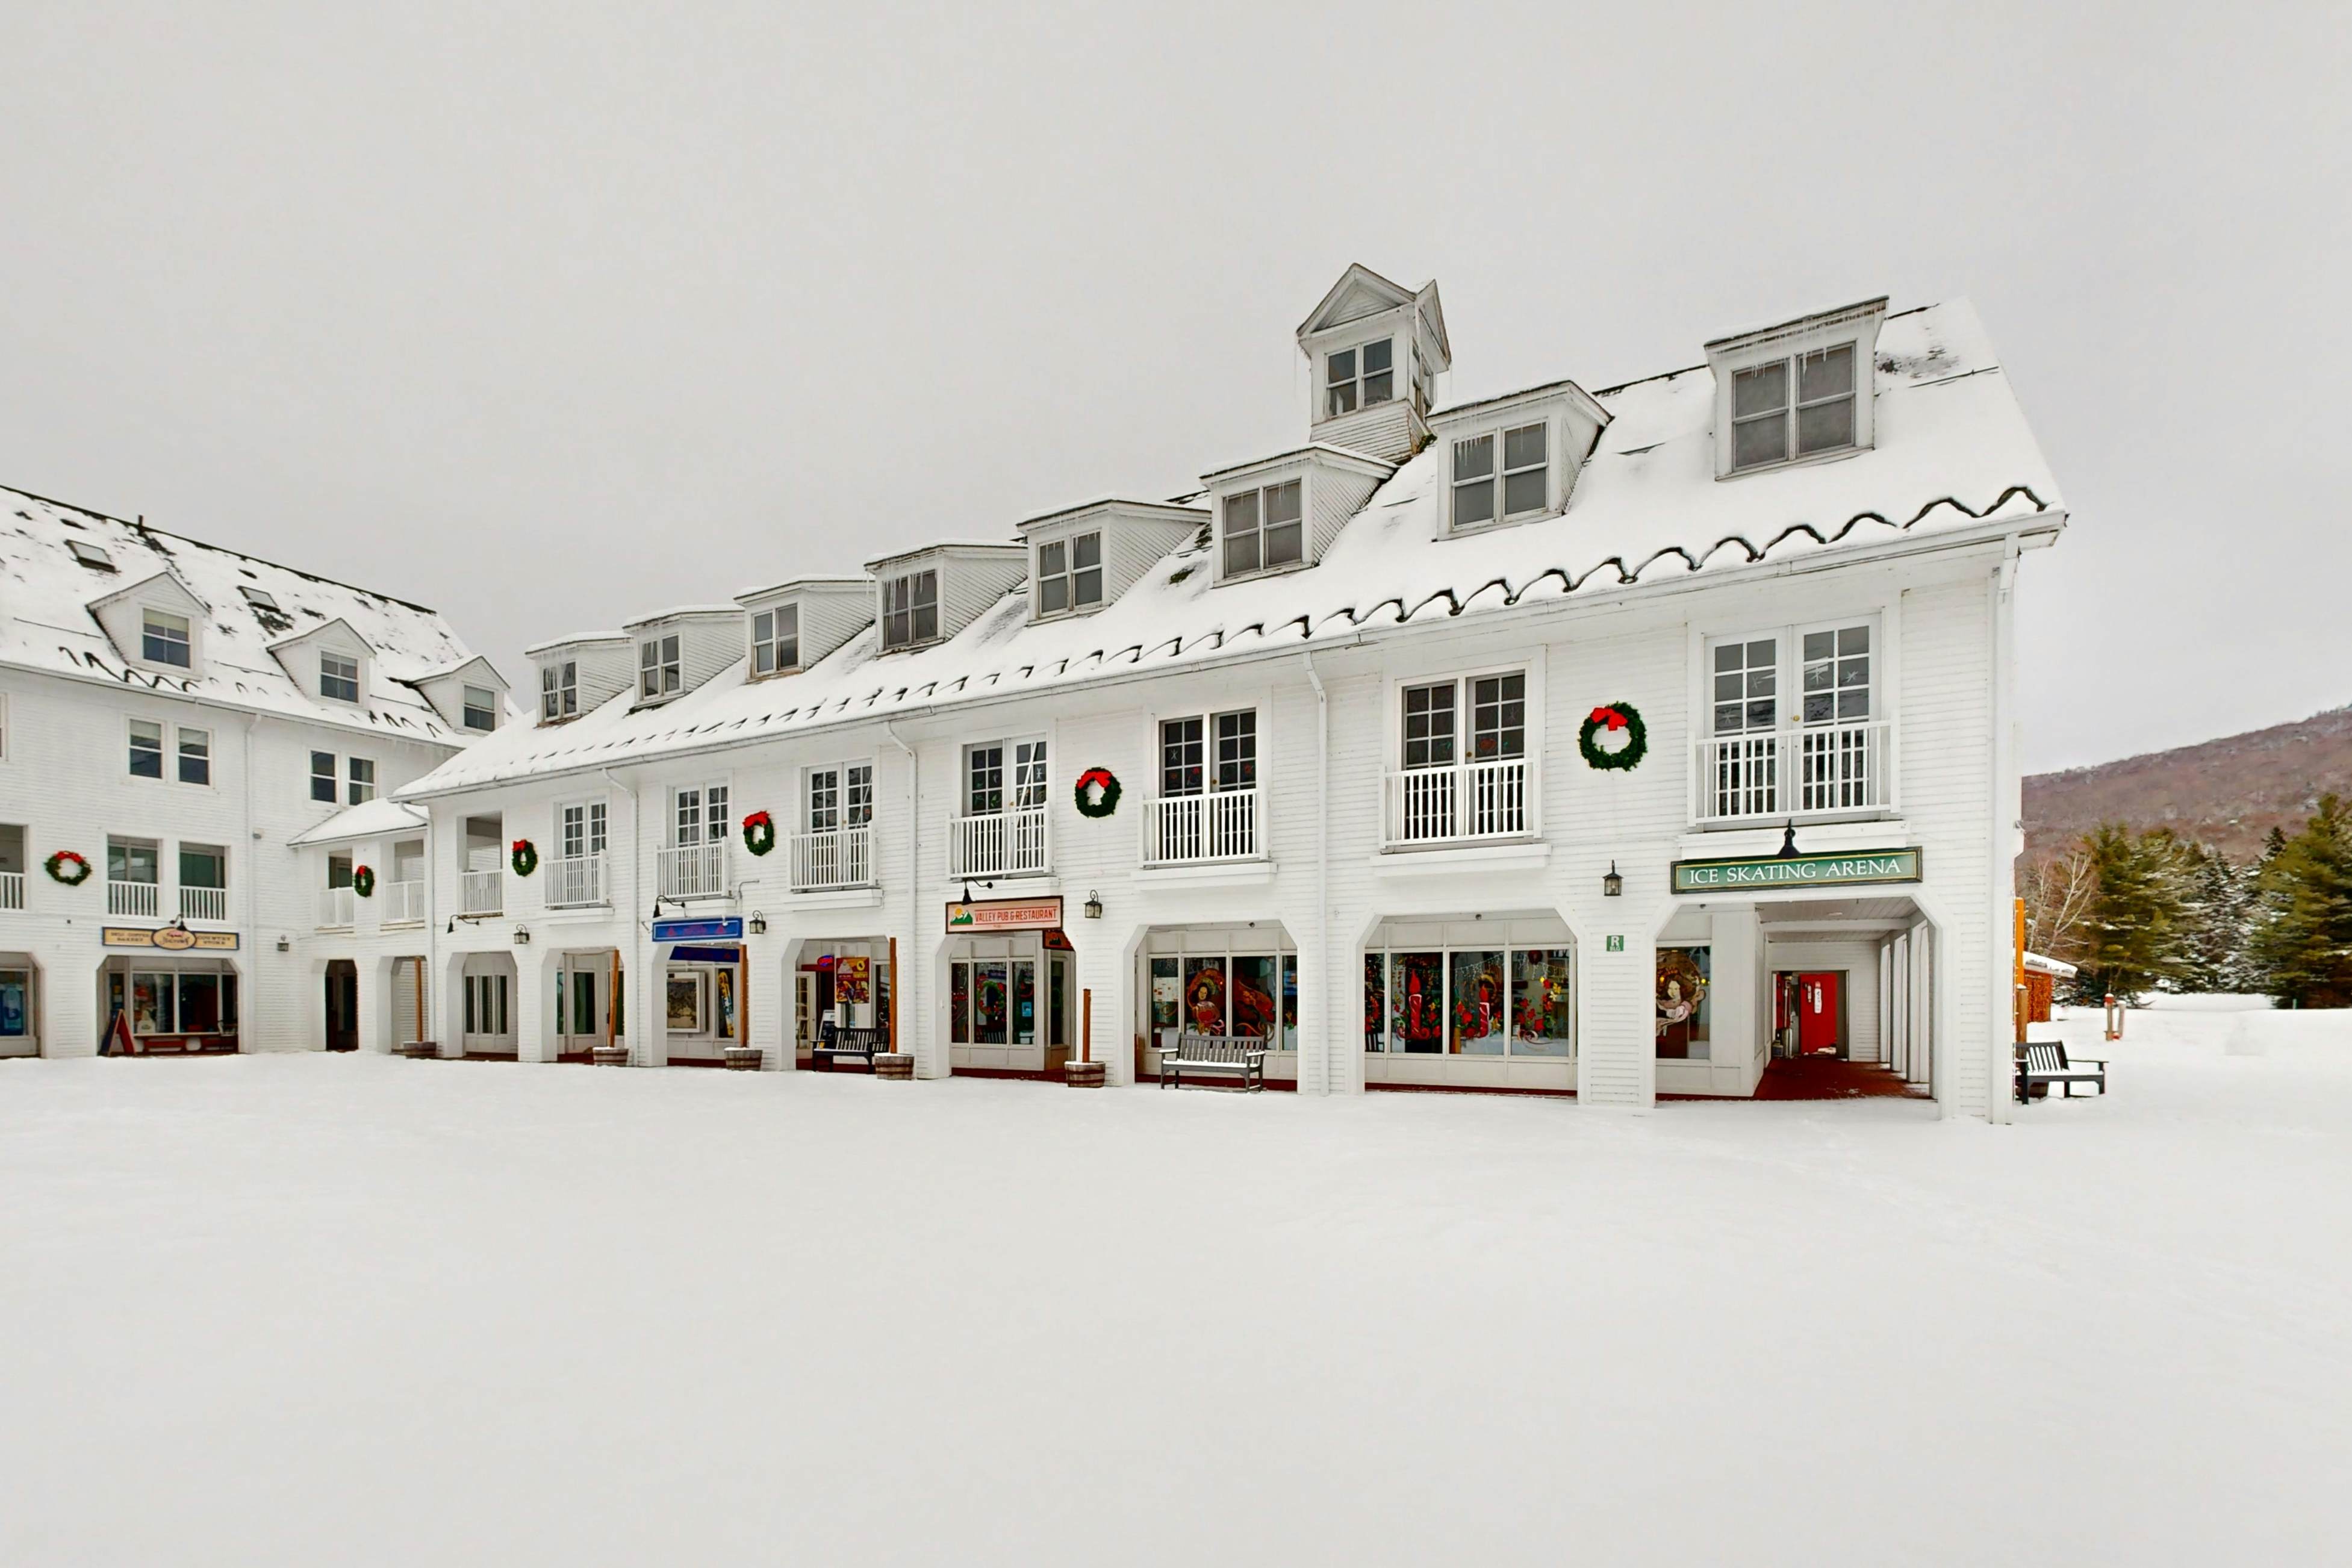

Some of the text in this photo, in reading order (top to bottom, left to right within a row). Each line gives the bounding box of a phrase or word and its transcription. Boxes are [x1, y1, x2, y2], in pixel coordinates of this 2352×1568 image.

[1689, 858, 1902, 884] ICE SKATING ARENA
[975, 912, 996, 922] VALLEY
[997, 911, 1009, 921] PUB
[1015, 908, 1057, 921] RESTAURANT
[1611, 936, 1620, 947] R
